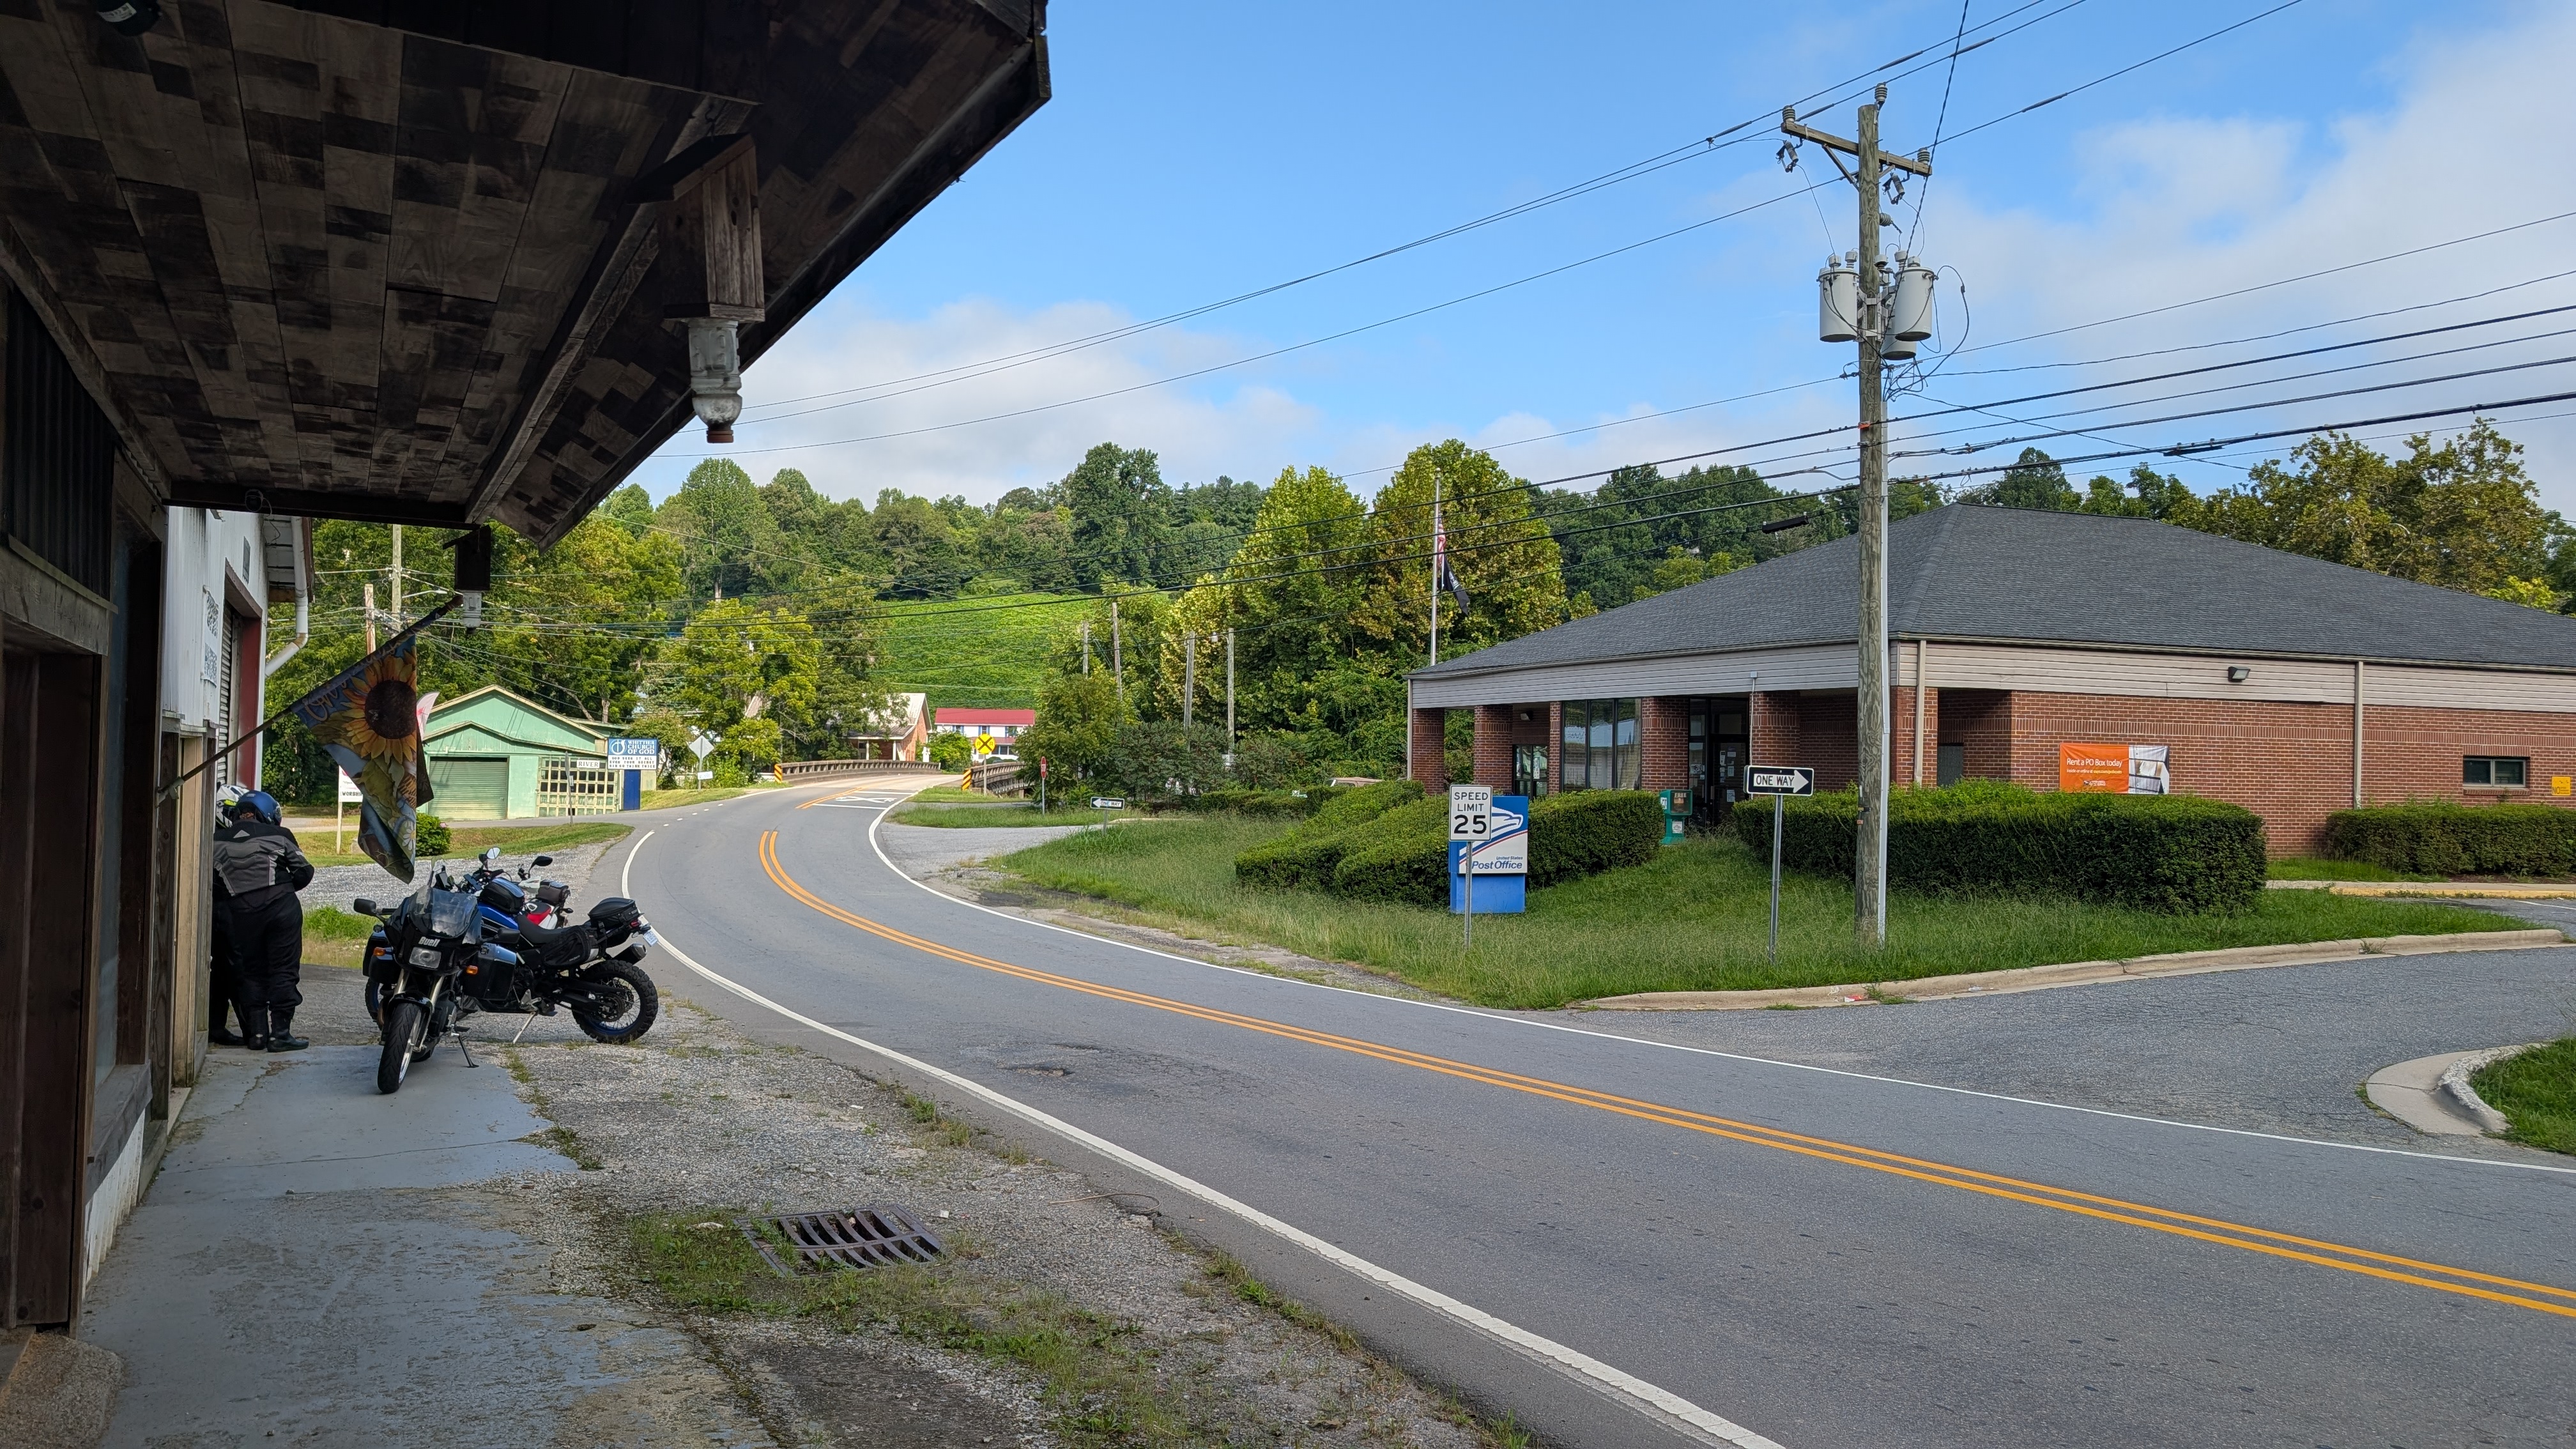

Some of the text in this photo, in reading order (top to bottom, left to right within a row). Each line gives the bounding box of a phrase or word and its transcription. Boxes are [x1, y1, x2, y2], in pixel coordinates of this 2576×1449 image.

[2106, 759, 2122, 768] today
[1756, 775, 1795, 786] ONE WAY
[2551, 786, 2560, 795] NO
[1453, 792, 1489, 801] SPEED
[1457, 803, 1484, 812] LIMIT
[1453, 814, 1487, 834] 25
[1472, 860, 1522, 870] Post Office
[418, 936, 441, 947] Buell
